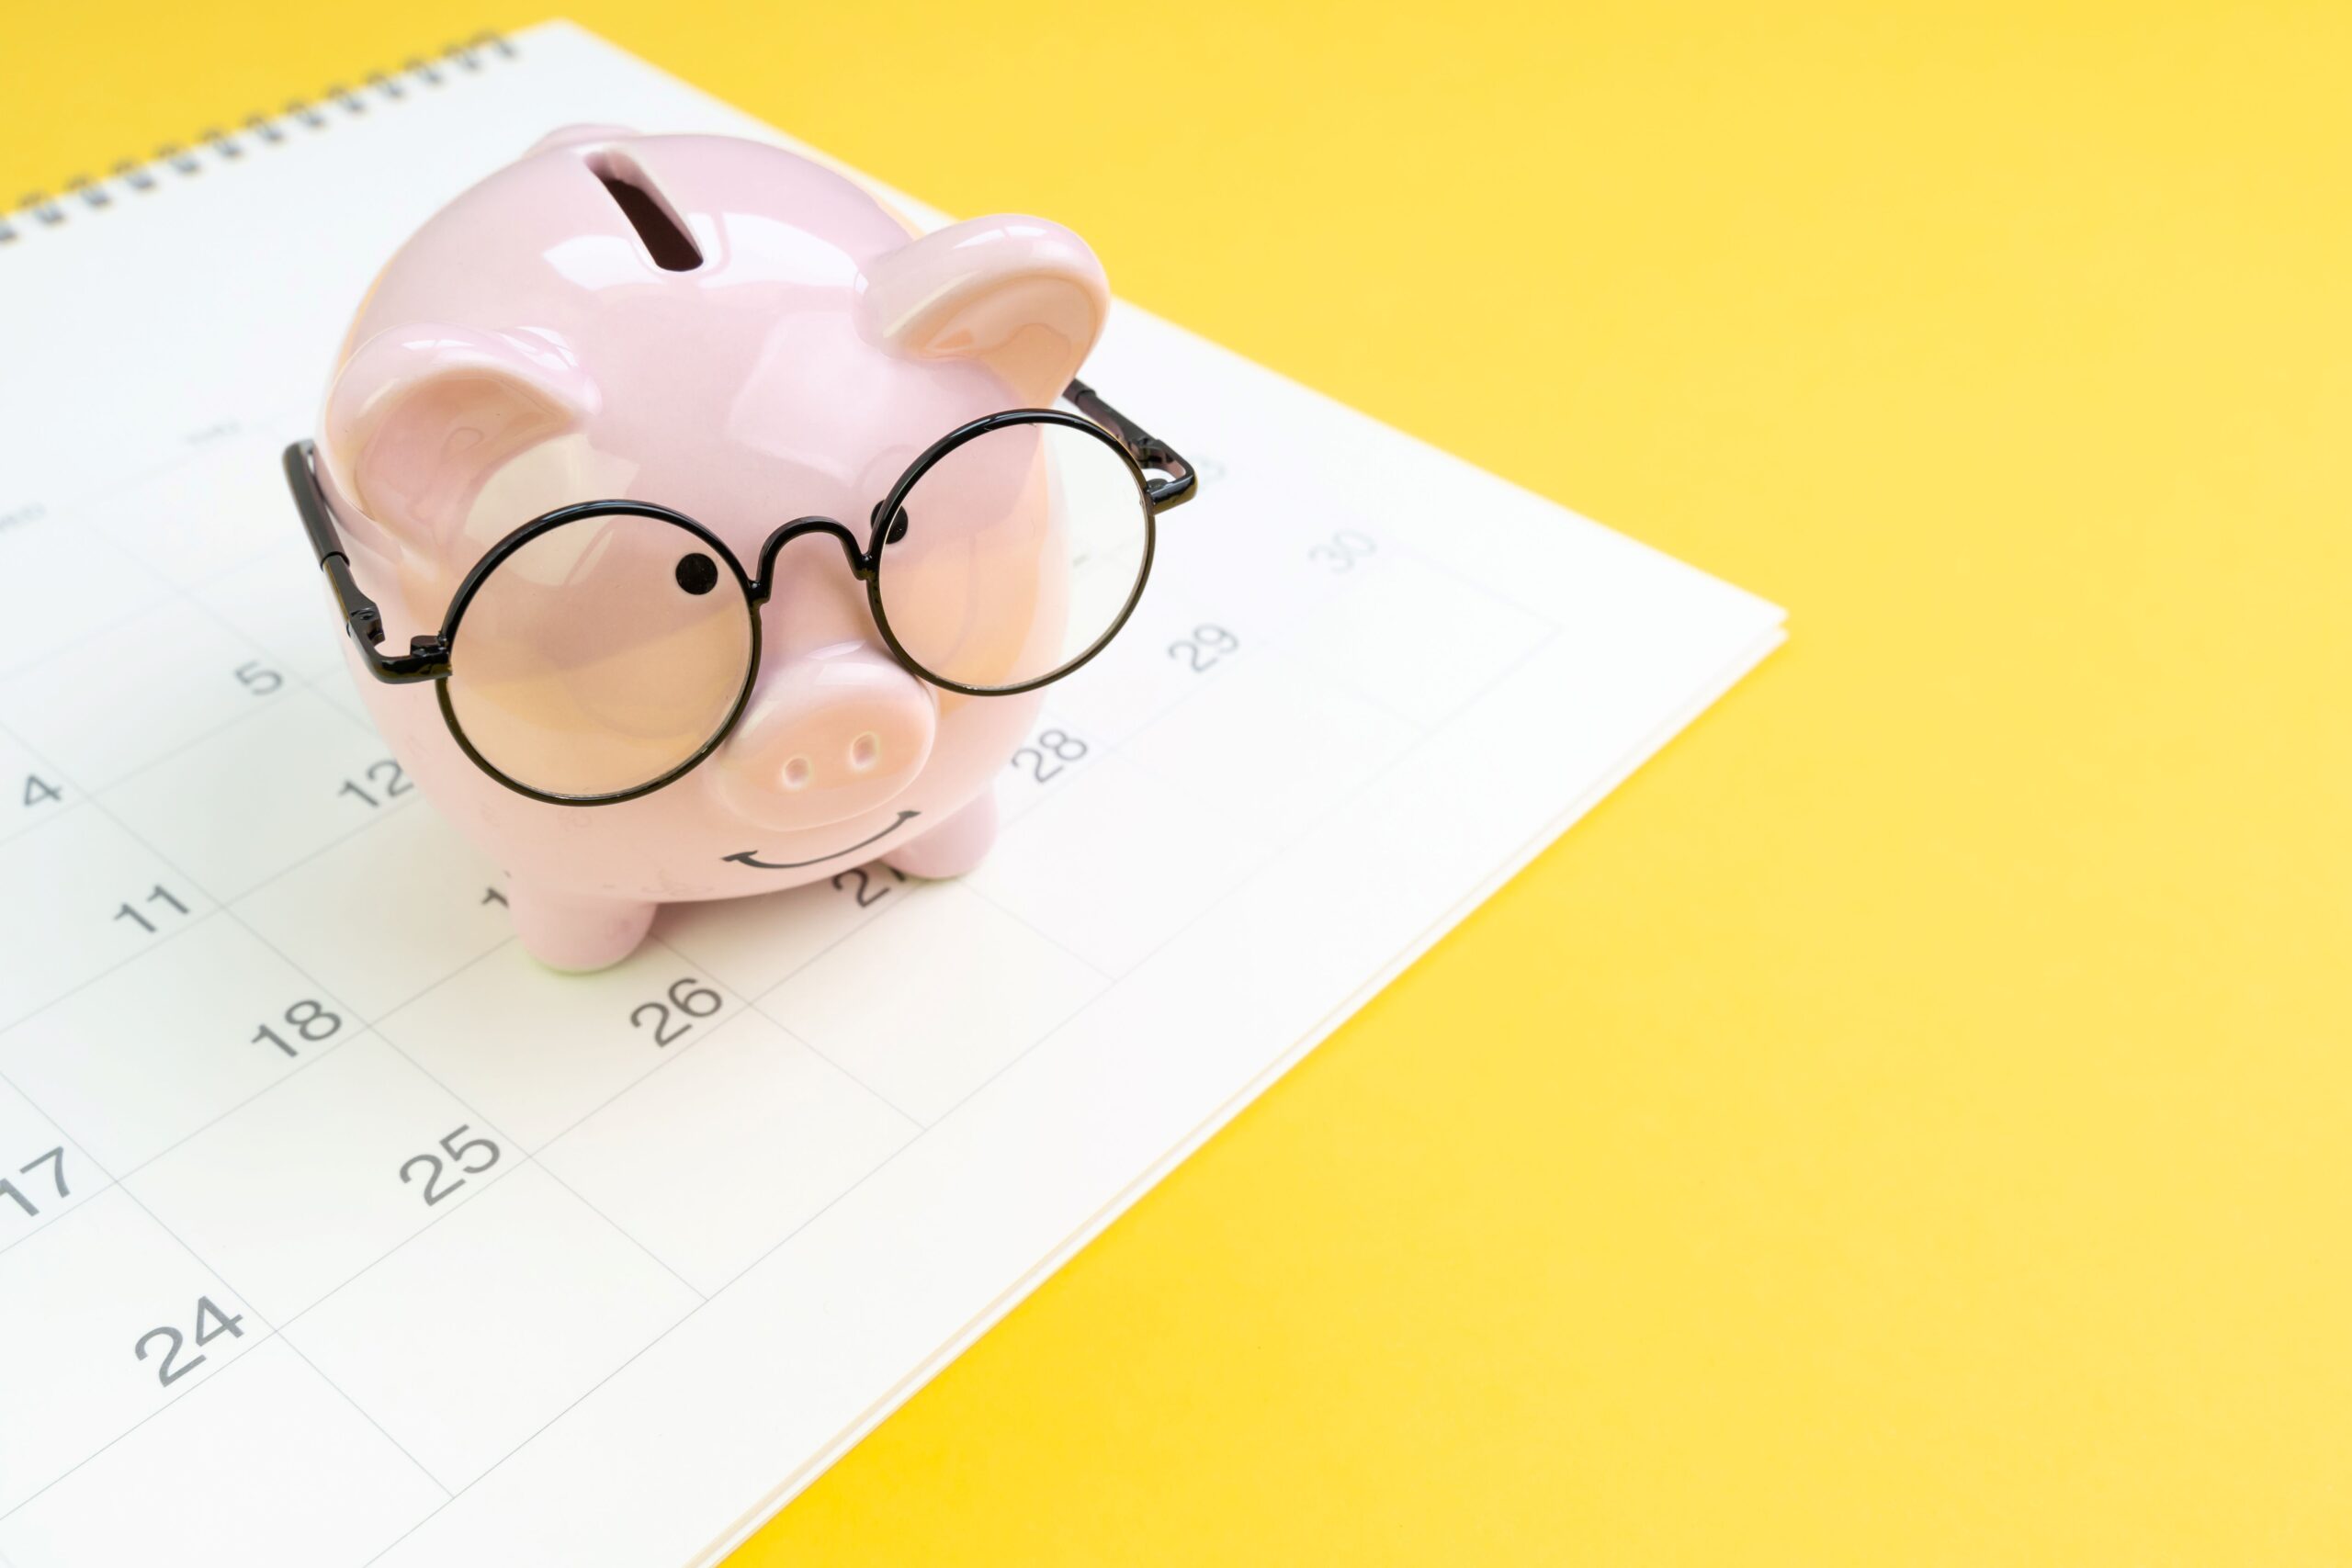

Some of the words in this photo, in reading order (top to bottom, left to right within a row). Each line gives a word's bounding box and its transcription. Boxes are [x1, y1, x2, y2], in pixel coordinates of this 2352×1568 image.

[1306, 528, 1379, 576] 30
[1167, 624, 1240, 674] 29
[232, 660, 285, 696] 5
[1011, 728, 1090, 785] 28
[23, 773, 62, 807] 4
[338, 758, 414, 808] 12
[113, 885, 190, 934] 11
[831, 866, 907, 908] 2
[251, 998, 343, 1058] 18
[629, 977, 723, 1048] 26
[0, 1145, 71, 1217] 17
[399, 1123, 501, 1207] 25
[134, 1295, 244, 1388] 24
